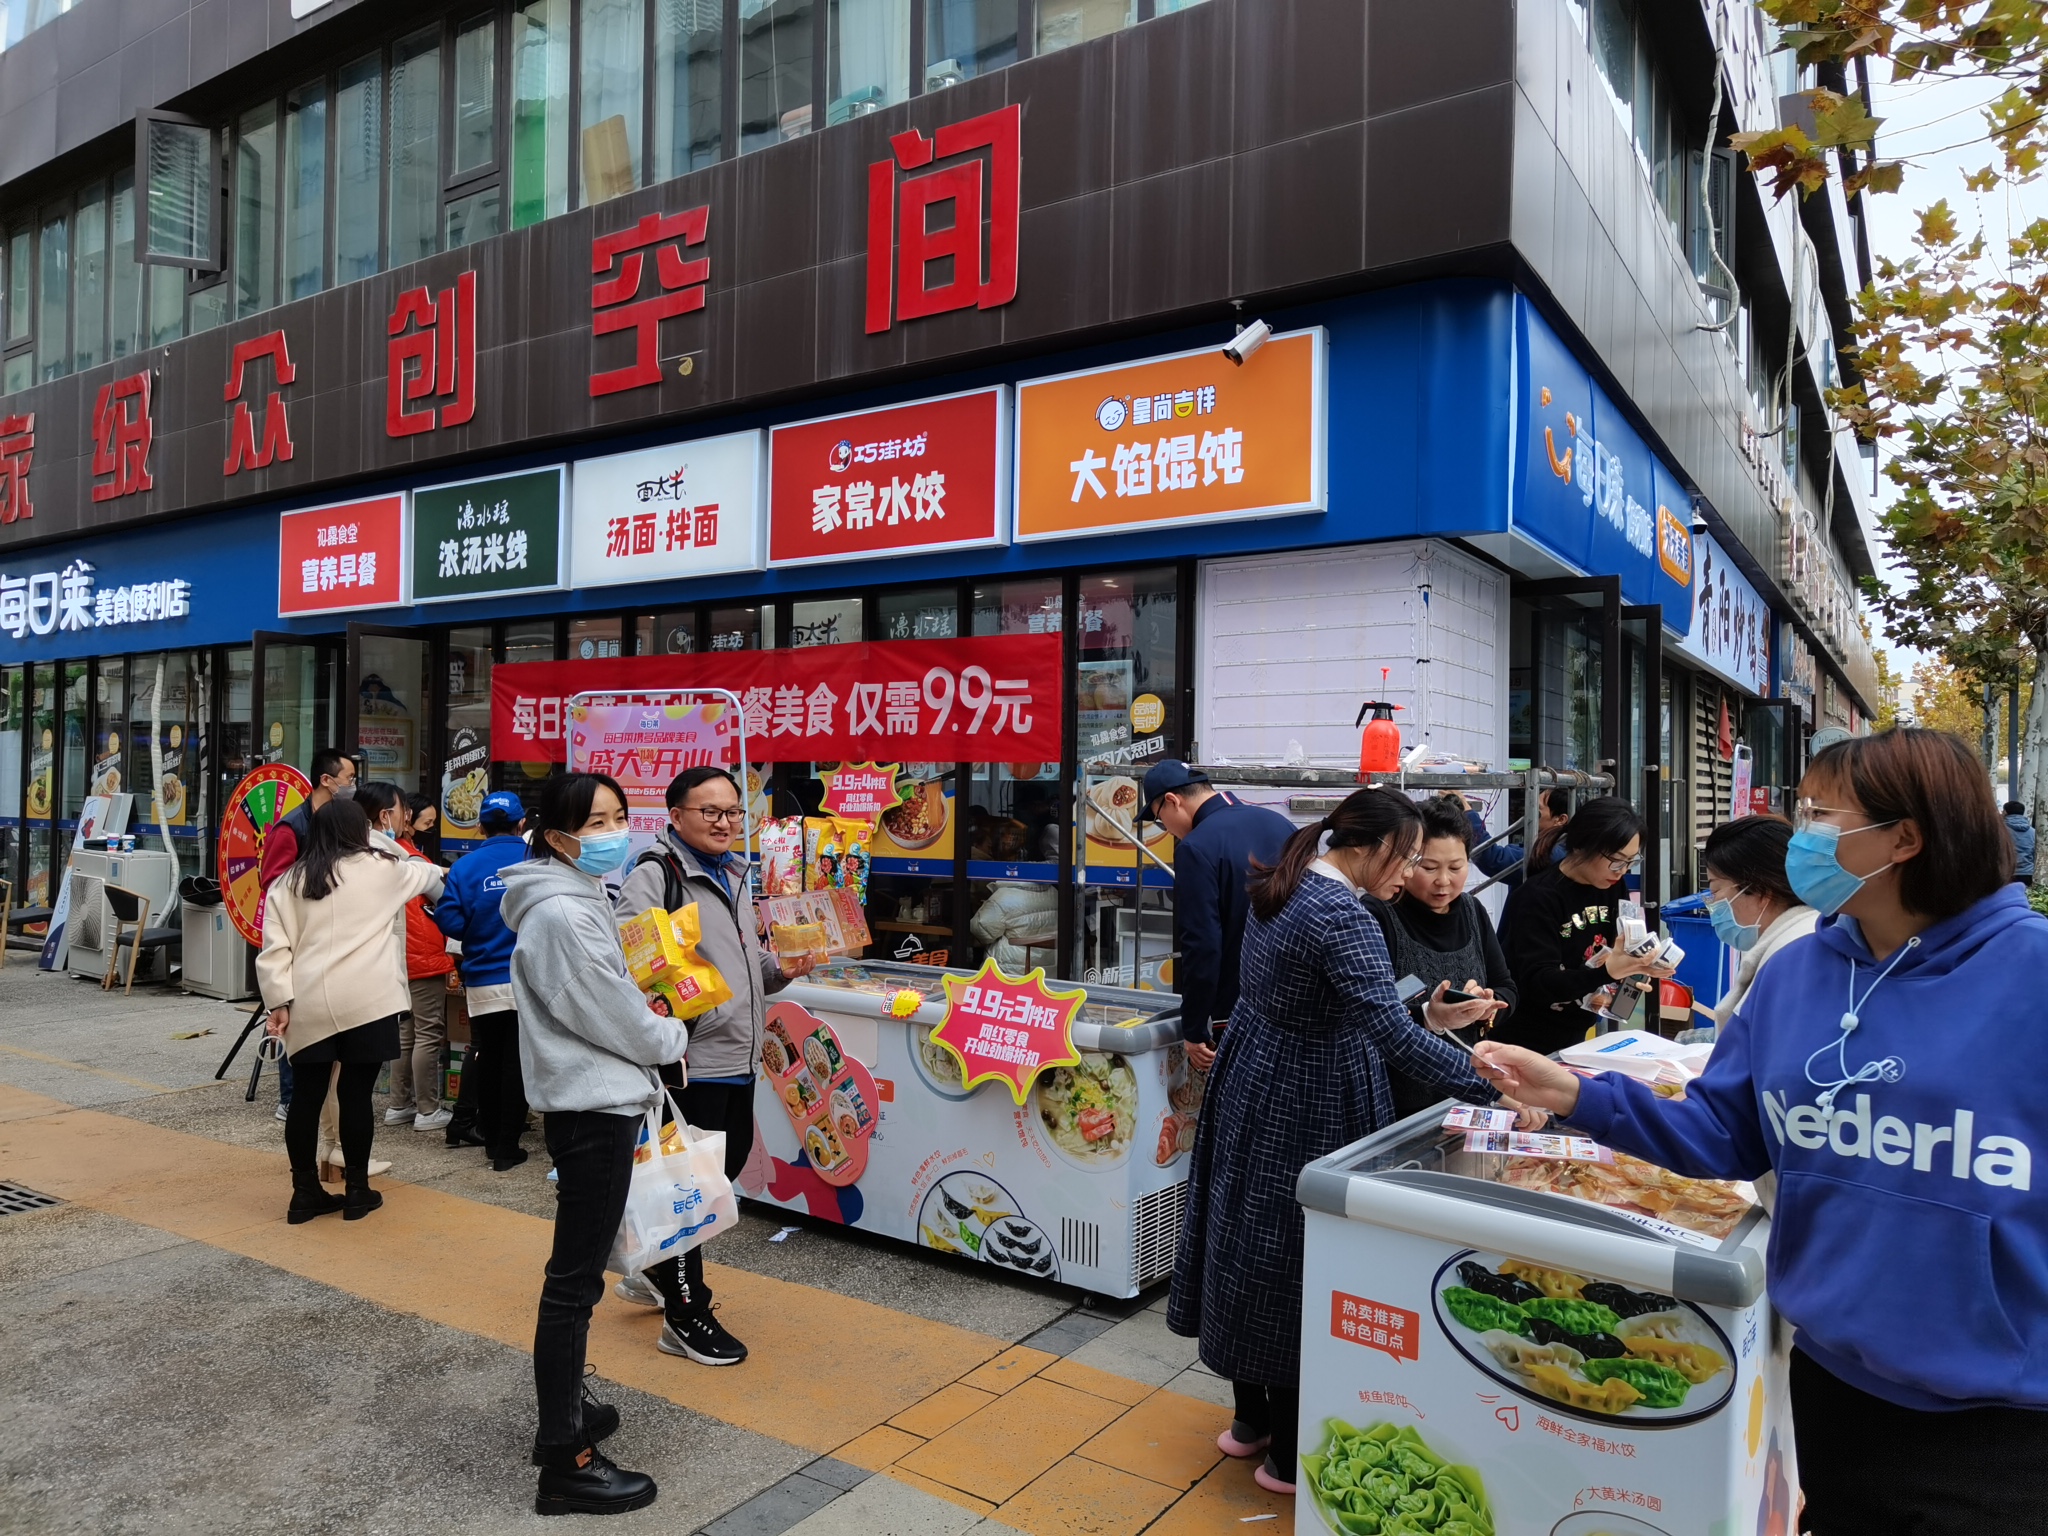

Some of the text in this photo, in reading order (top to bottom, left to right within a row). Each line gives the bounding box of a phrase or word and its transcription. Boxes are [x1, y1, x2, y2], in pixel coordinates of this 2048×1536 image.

[1132, 385, 1217, 425] 皇尚吉祥
[854, 434, 927, 462] 巧街坊
[1070, 427, 1244, 503] 大馅馄饨
[812, 471, 946, 534] 家常水饺
[606, 503, 720, 558] 汤面·拌面
[302, 552, 377, 593] 营养早餐
[438, 530, 528, 578] 浓汤米线
[94, 578, 191, 628] 美食便利店
[845, 665, 1033, 736] 仅需9.9元
[832, 774, 887, 791] 9.9元4件区
[845, 793, 873, 803] 网红零食
[960, 986, 1059, 1030] 9.9元3件区
[964, 1037, 1040, 1067] 开业劲爆折扣
[979, 1023, 1029, 1047] 网红零食
[1762, 1090, 2032, 1191] Nederla
[1341, 1318, 1404, 1351] 特色面点
[1342, 1298, 1405, 1331] 热卖推荐
[1358, 1389, 1408, 1409] 鲅鱼馄饨
[1535, 1413, 1637, 1459] 海鲜全家福水饺
[1587, 1485, 1662, 1512] 大黄米汤圆
